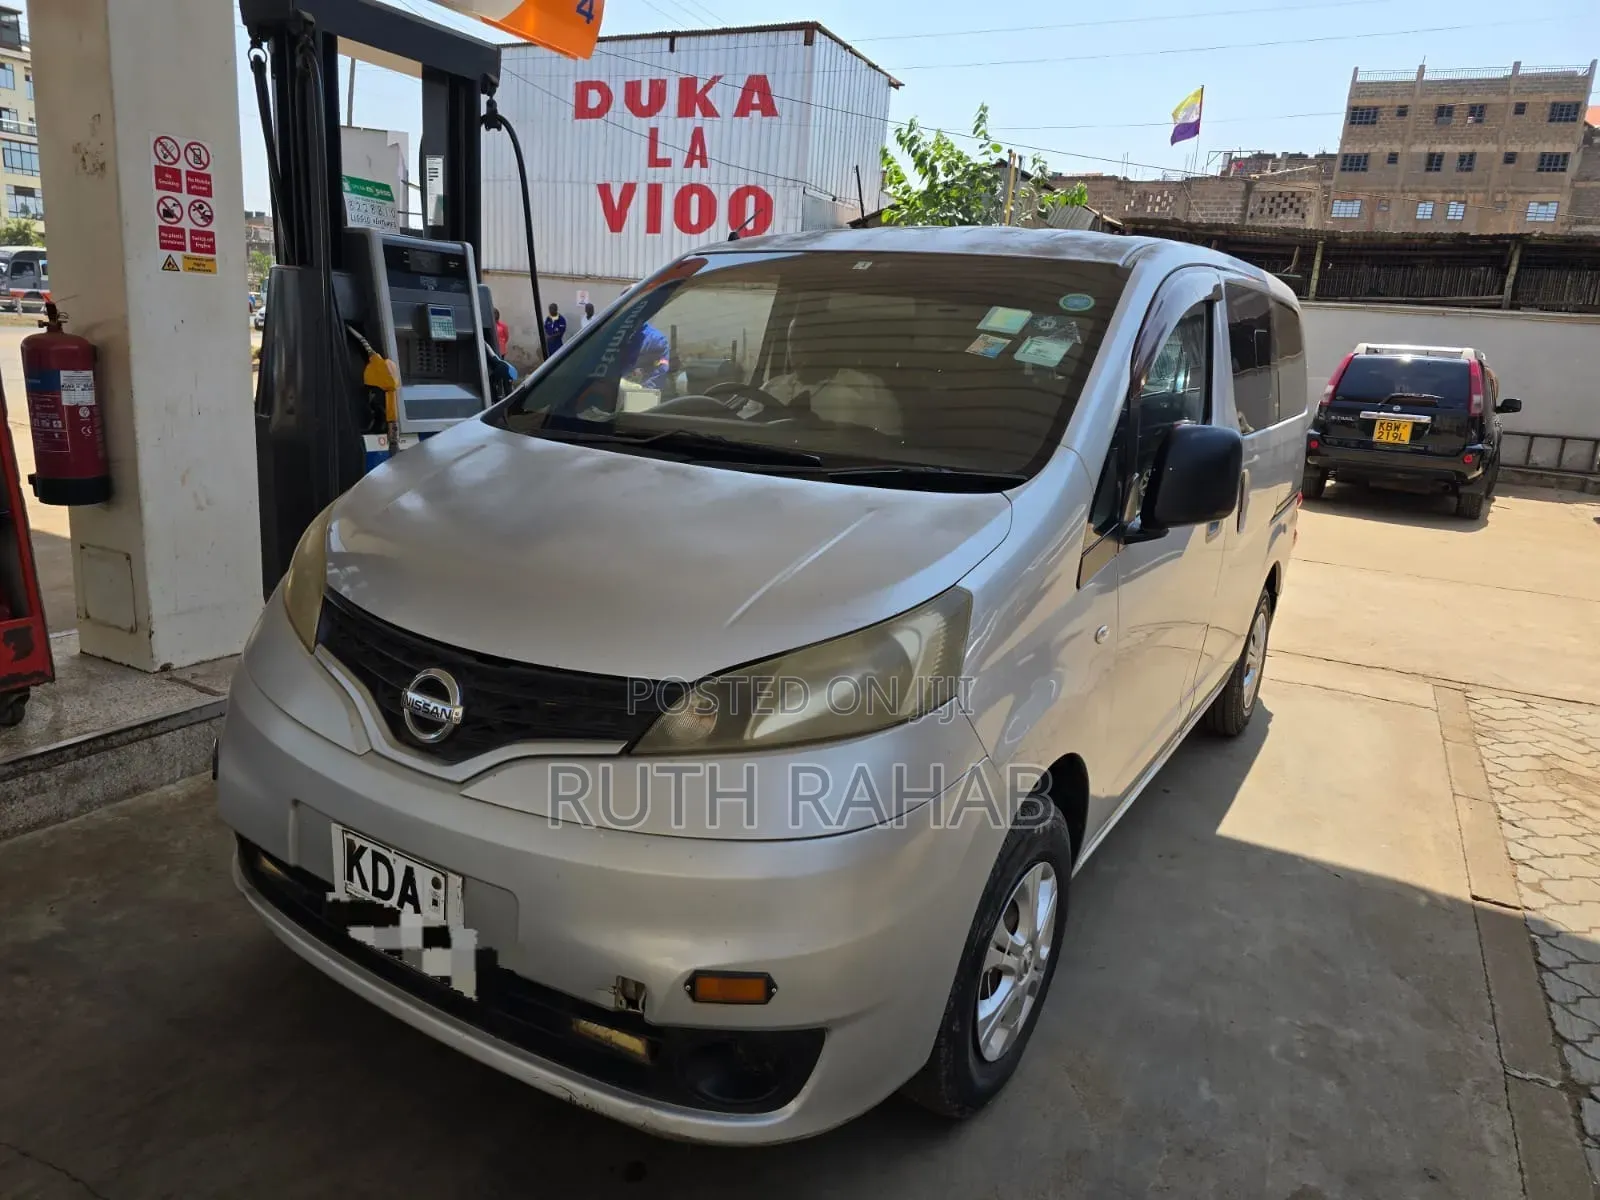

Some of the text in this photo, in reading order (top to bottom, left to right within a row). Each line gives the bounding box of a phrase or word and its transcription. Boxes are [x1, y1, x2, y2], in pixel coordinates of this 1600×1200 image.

[574, 74, 779, 120] DUKA
[647, 126, 709, 168] LA
[597, 182, 774, 238] VIOO
[1376, 431, 1405, 442] 219L
[1378, 421, 1403, 432] KBW
[403, 694, 452, 719] NISSAN
[347, 838, 422, 914] KDA
